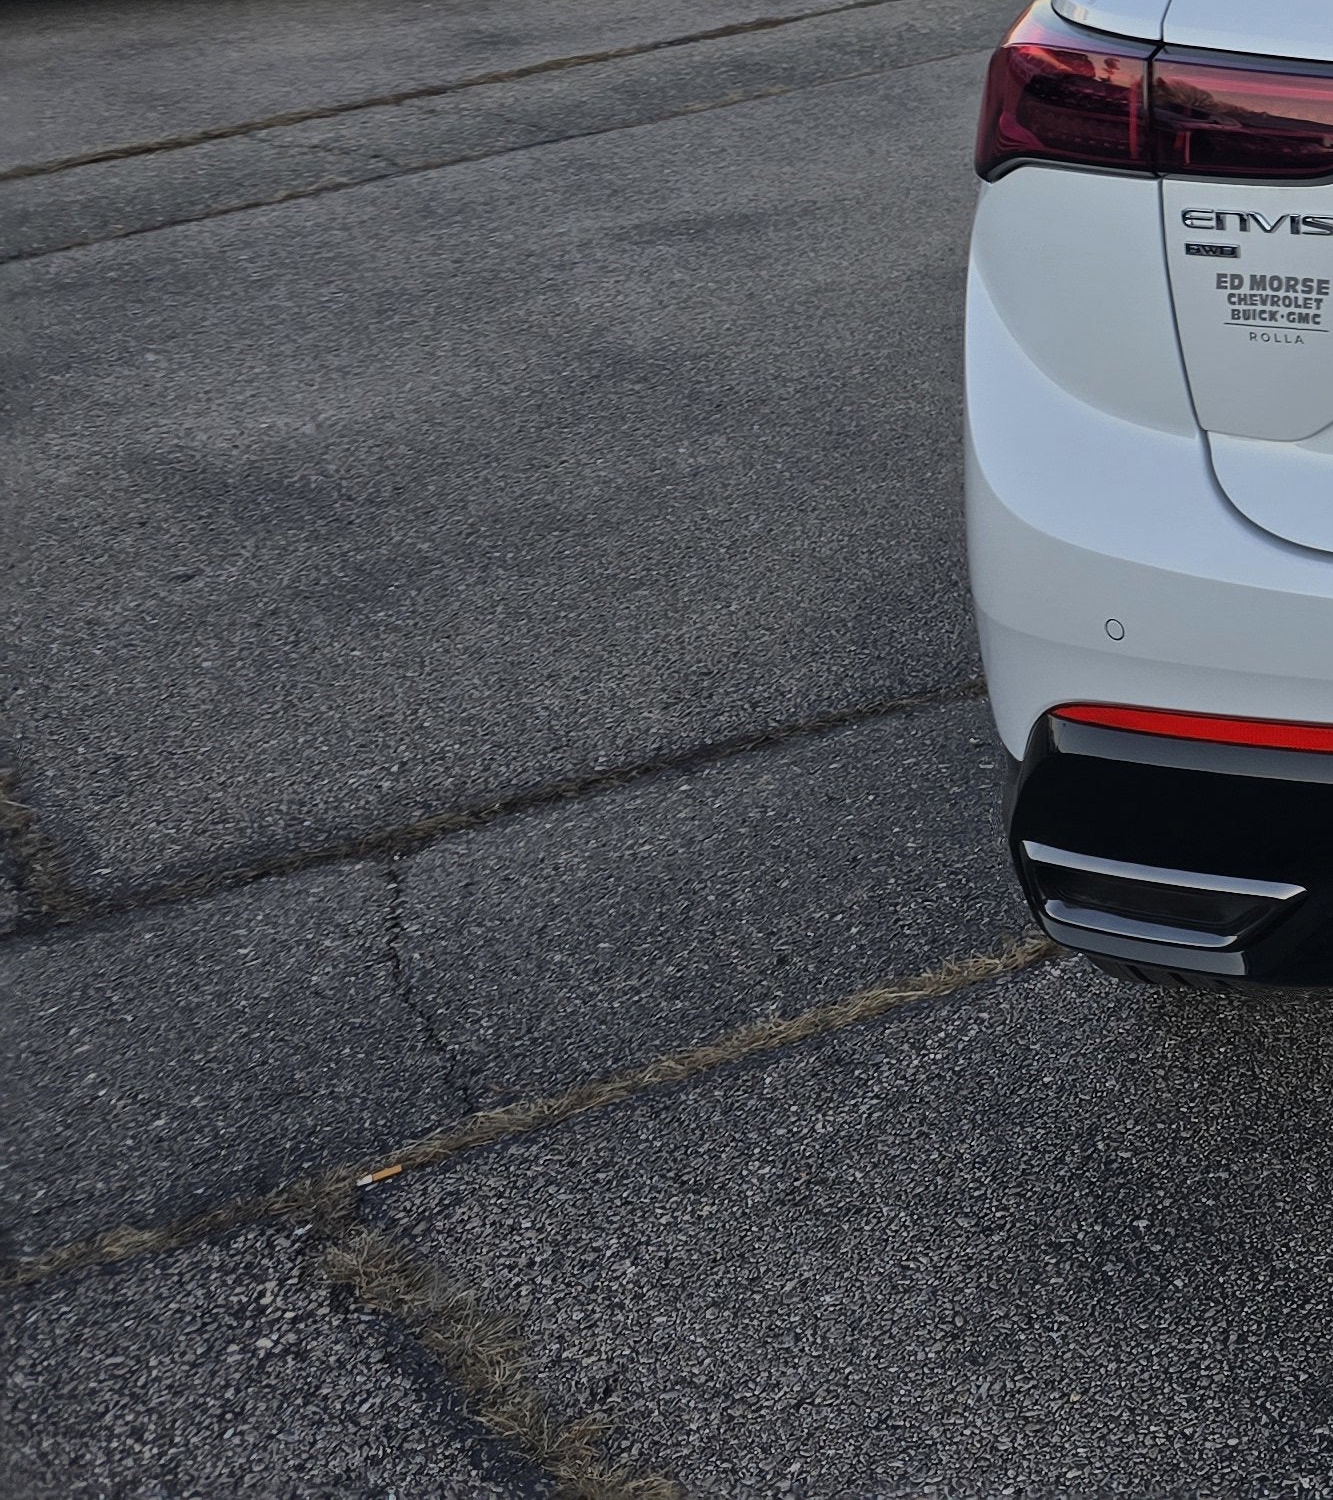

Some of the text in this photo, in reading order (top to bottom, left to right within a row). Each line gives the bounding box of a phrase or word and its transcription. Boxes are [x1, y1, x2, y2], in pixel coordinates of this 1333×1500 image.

[1216, 273, 1330, 296] ED MORSE
[1227, 293, 1323, 310] CHEVROLET
[1249, 332, 1304, 345] ROLLA
